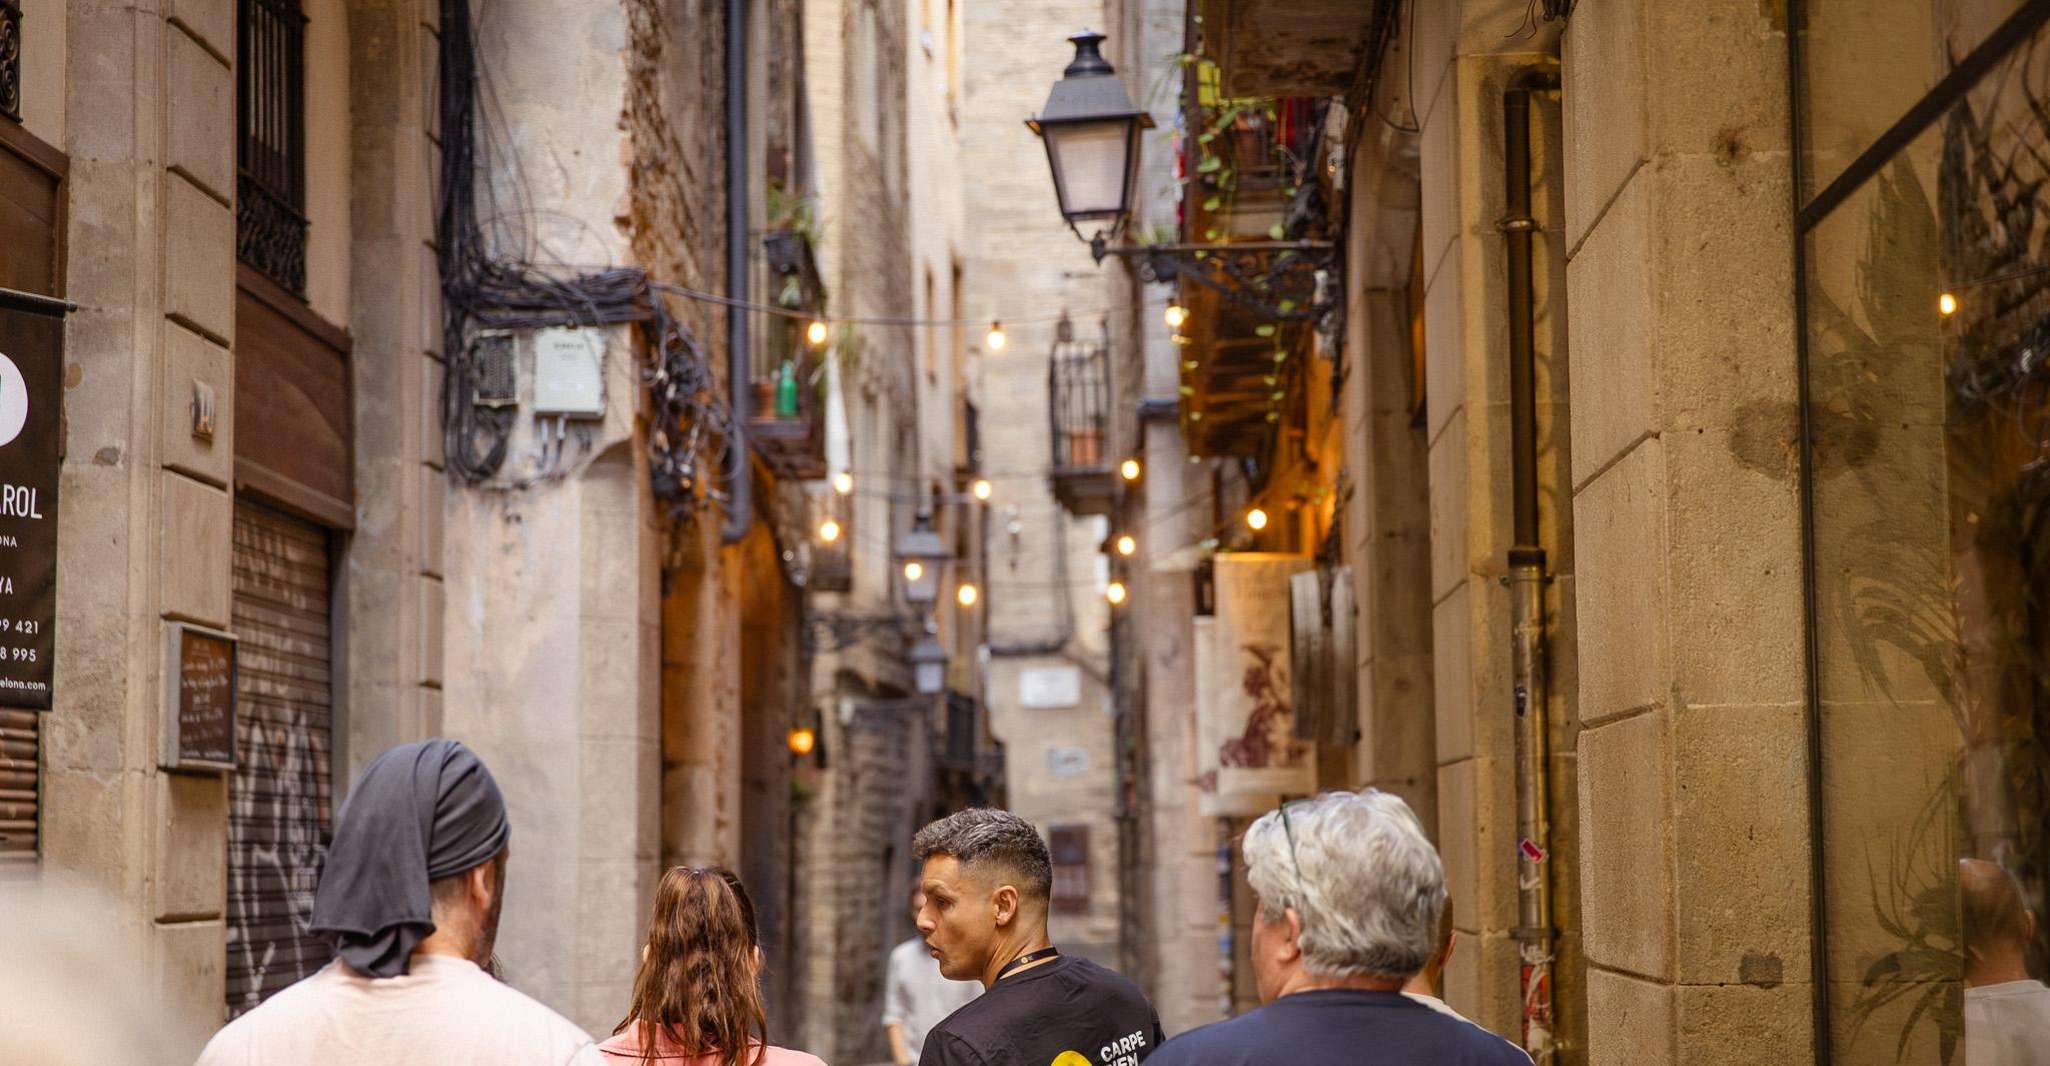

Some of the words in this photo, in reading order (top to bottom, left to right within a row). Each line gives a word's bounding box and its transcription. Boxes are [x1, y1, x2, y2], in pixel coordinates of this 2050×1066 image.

[0, 484, 43, 519] ROL
[0, 618, 10, 632] 9
[15, 620, 38, 634] 421
[12, 647, 36, 662] 995
[1100, 1030, 1146, 1062] CARPE
